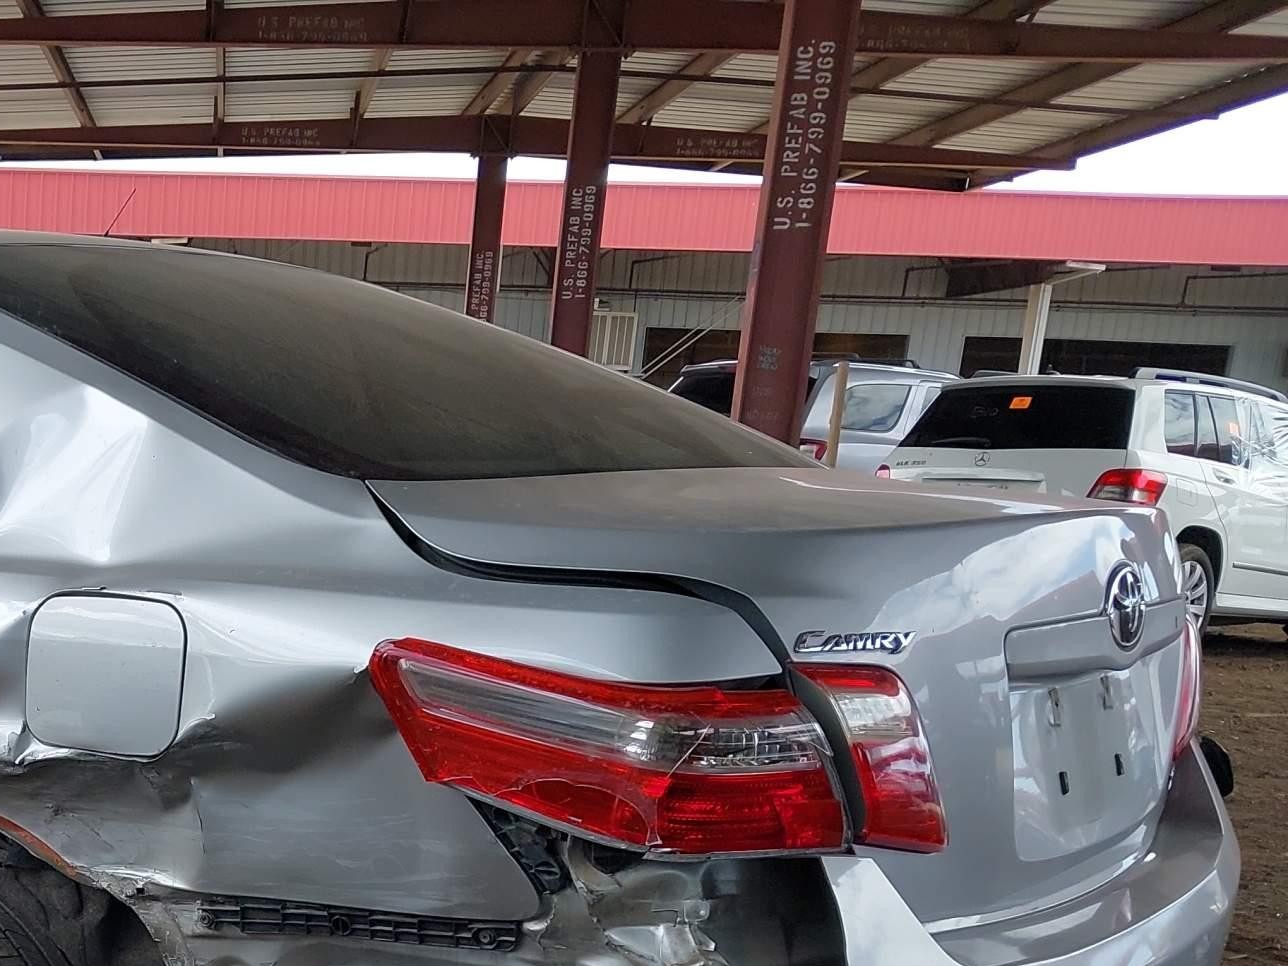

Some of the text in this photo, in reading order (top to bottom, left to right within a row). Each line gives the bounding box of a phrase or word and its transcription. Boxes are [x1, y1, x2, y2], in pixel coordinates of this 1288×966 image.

[772, 39, 816, 230] U.S. PREFAB INC.
[795, 41, 836, 228] 1-866-799-0969
[565, 216, 581, 267] PREFAB
